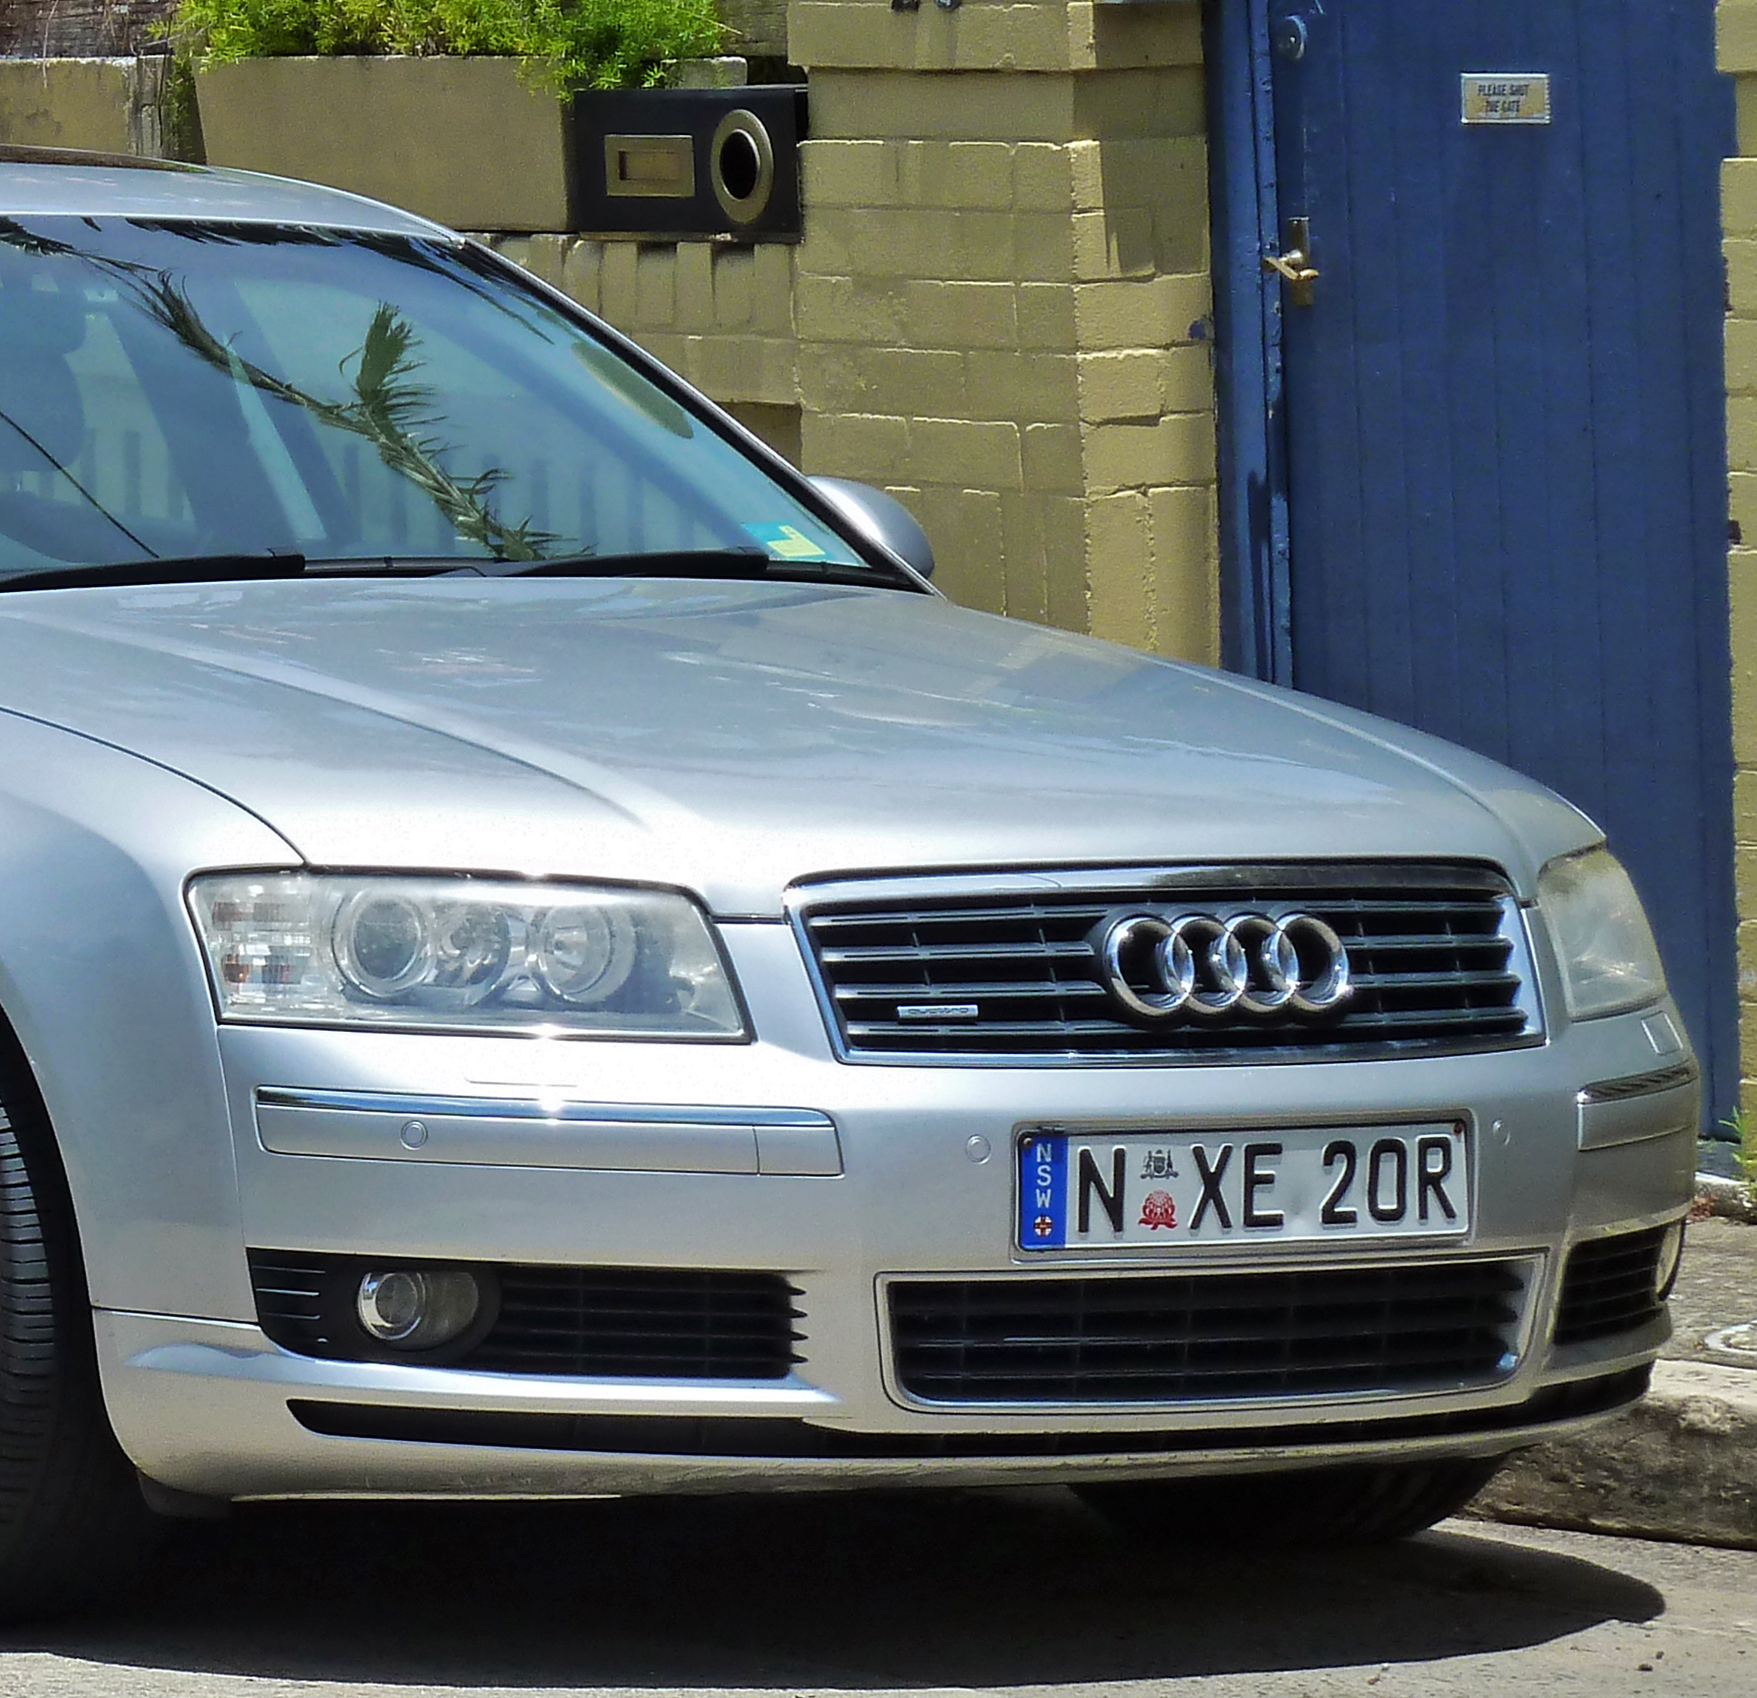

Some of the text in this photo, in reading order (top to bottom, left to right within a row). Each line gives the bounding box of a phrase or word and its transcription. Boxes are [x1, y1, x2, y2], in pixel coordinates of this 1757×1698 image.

[1478, 84, 1506, 96] PLEASE
[1036, 1142, 1052, 1209] NSW
[1188, 1142, 1285, 1229] XE
